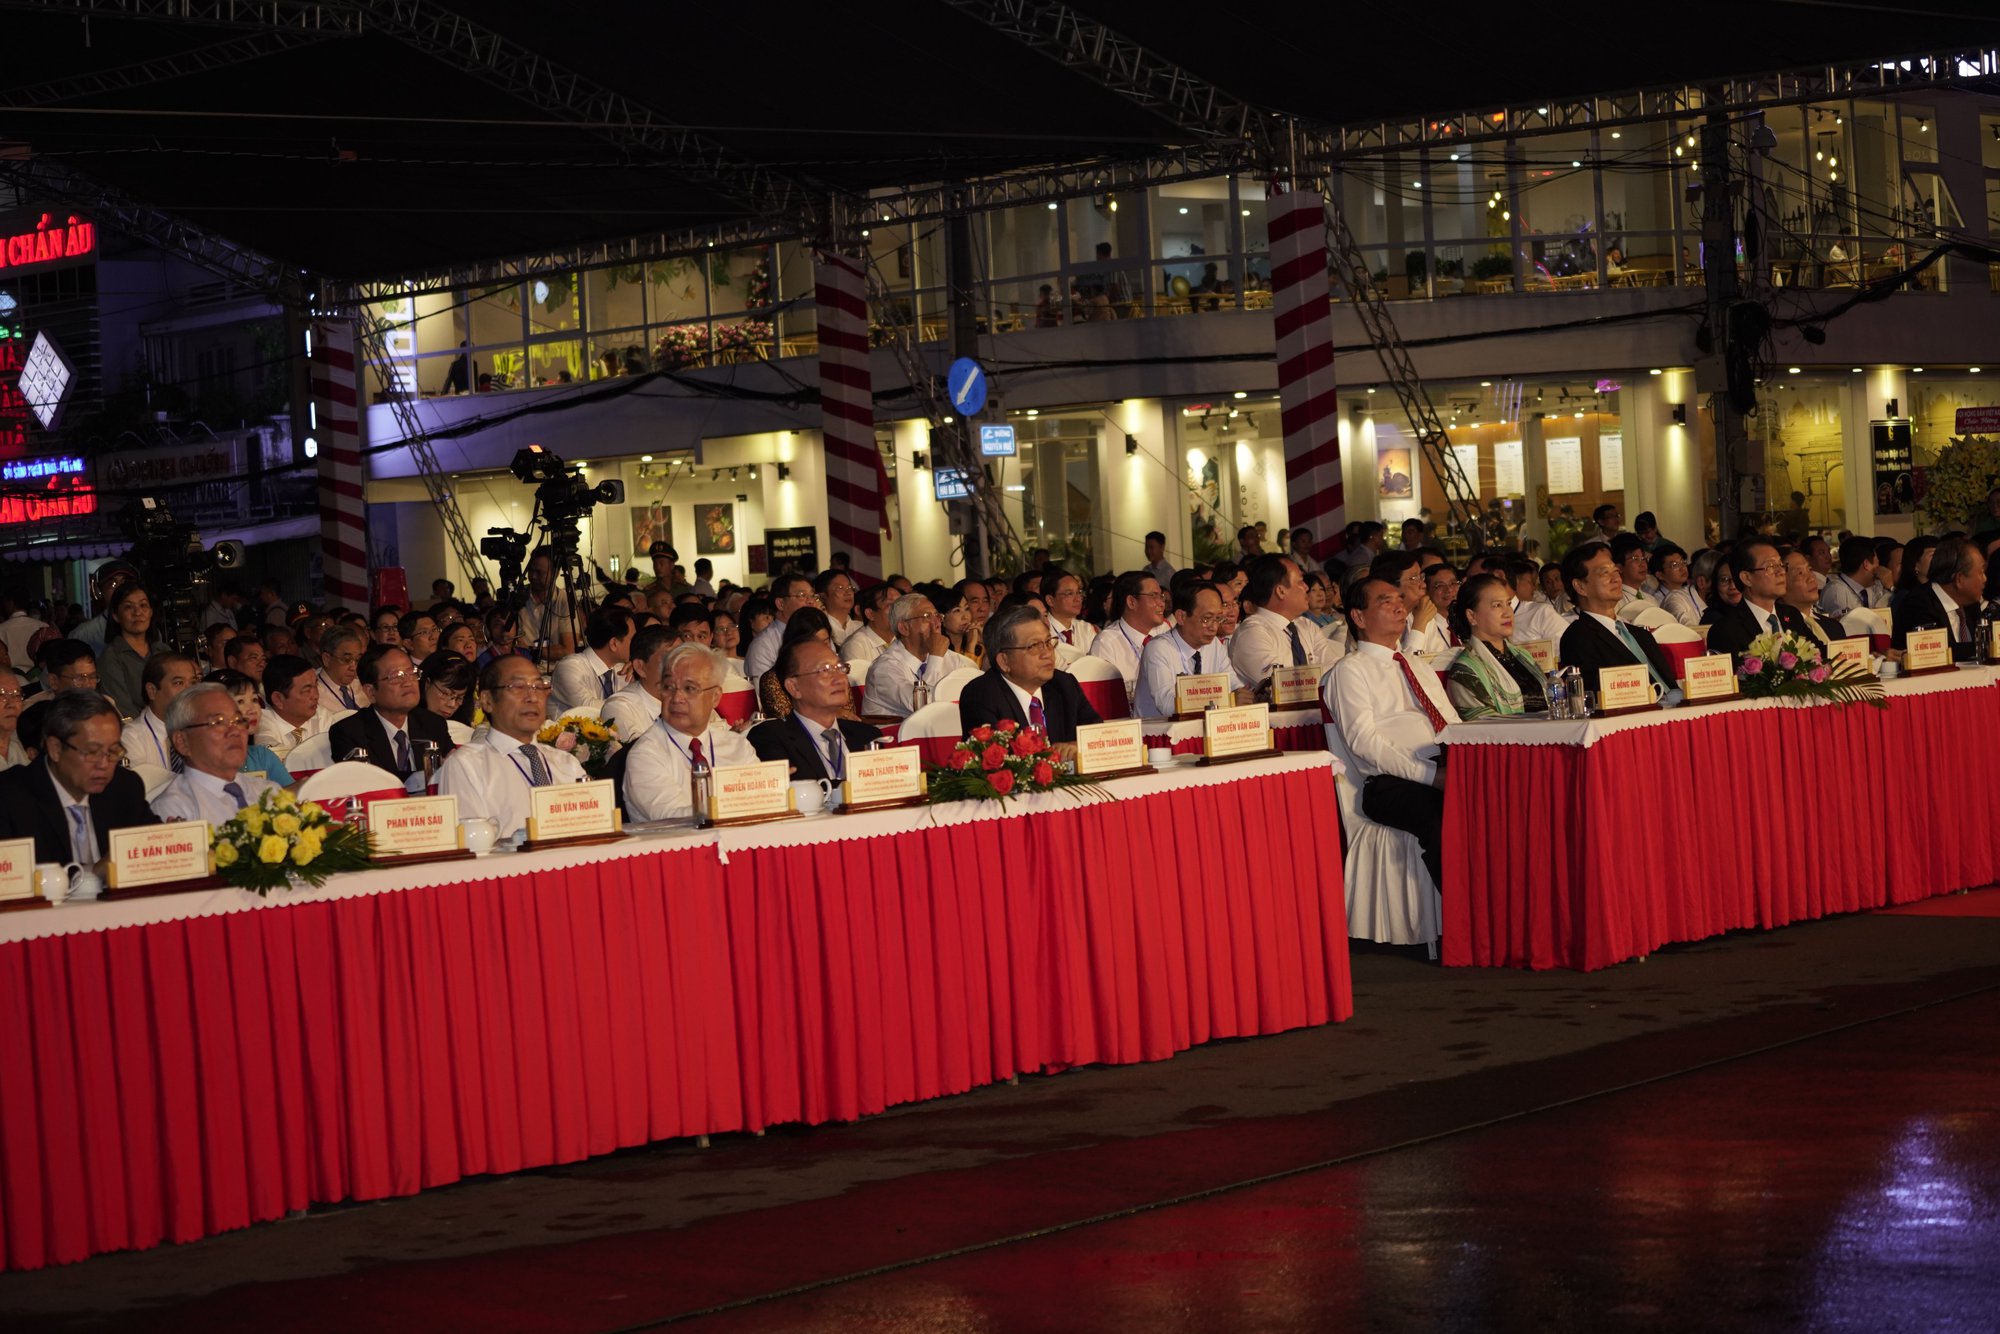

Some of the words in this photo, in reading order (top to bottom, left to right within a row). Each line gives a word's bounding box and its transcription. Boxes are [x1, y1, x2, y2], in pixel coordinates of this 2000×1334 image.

[1216, 722, 1237, 734] NGUYỄN
[1237, 720, 1247, 730] VĂN
[1087, 737, 1105, 750] NGUYỄN
[723, 778, 746, 793] NGUYỄN
[563, 800, 577, 812] VĂN
[386, 818, 408, 829] PHAN
[409, 815, 426, 827] VĂN
[127, 847, 139, 860] LÊ
[142, 845, 163, 858] VĂN
